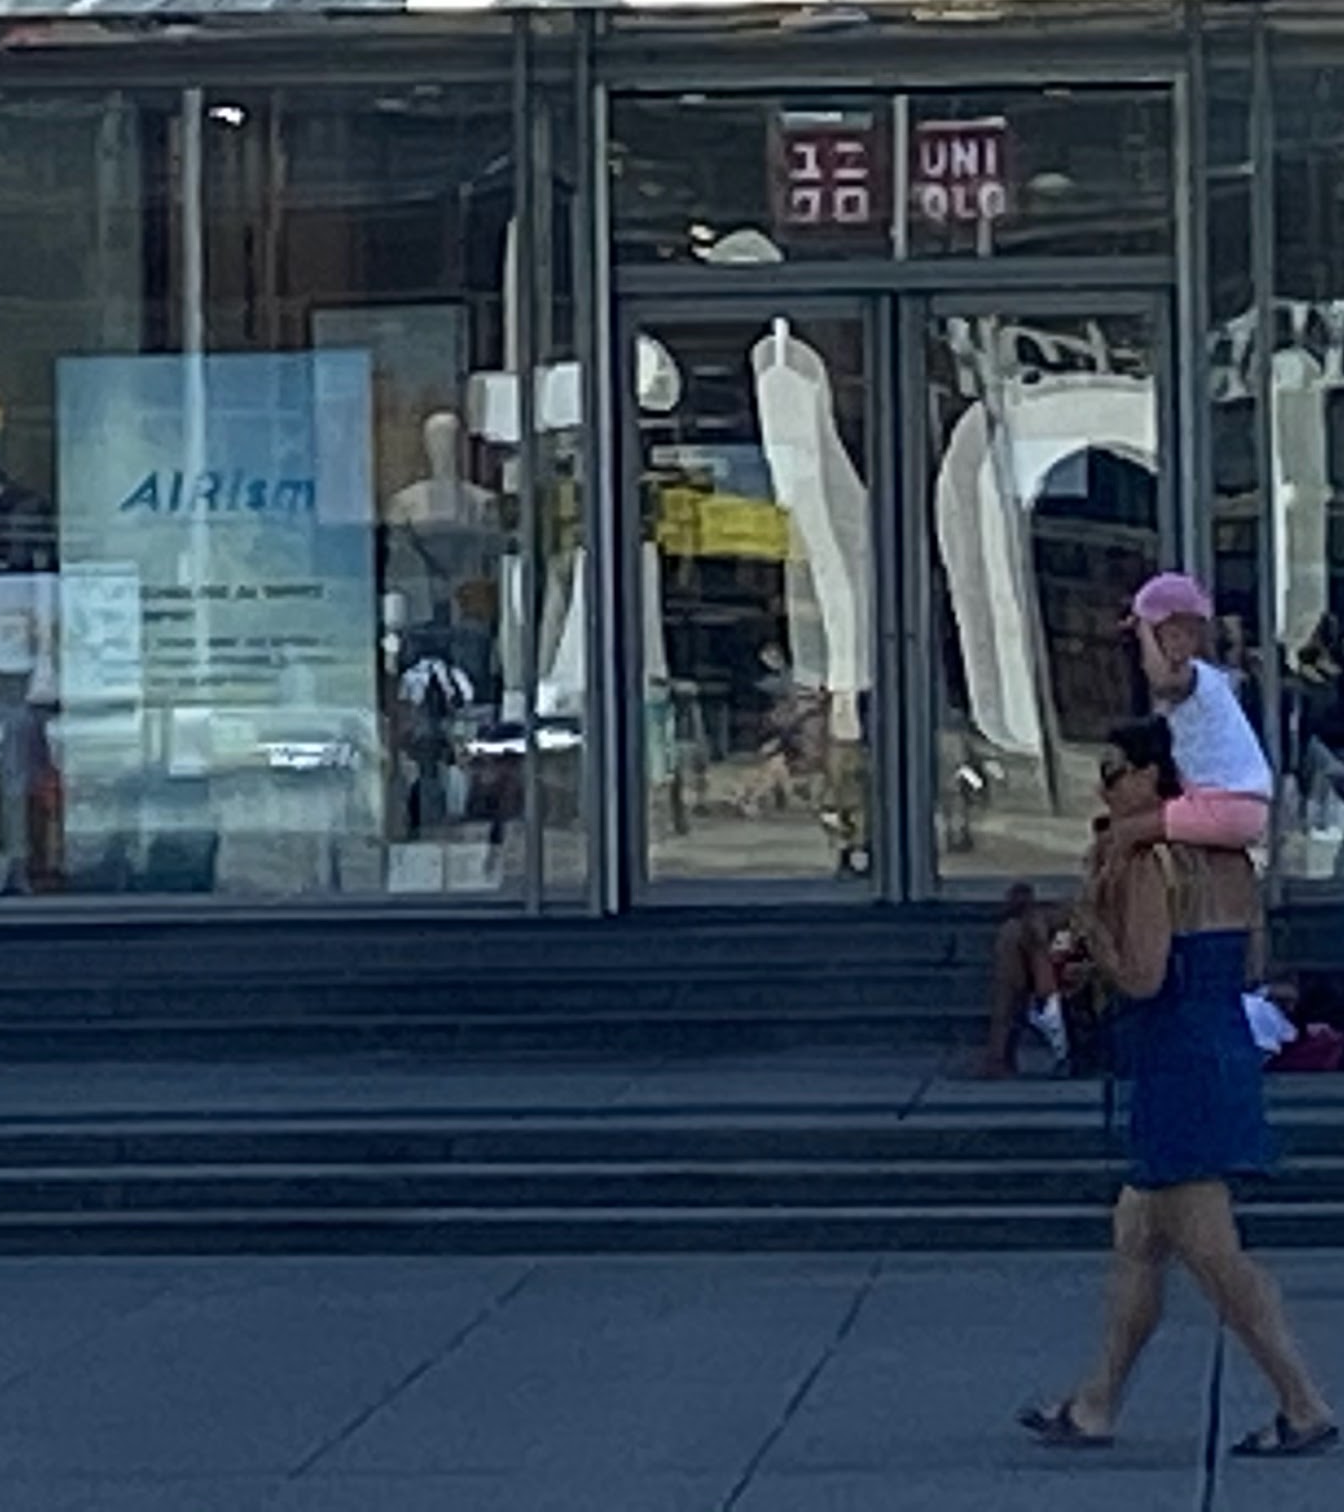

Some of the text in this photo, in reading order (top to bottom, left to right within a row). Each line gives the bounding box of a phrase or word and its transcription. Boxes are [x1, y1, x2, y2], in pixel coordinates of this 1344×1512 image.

[919, 138, 998, 177] UNI
[920, 183, 1006, 223] QLO
[119, 469, 316, 511] AIRism
